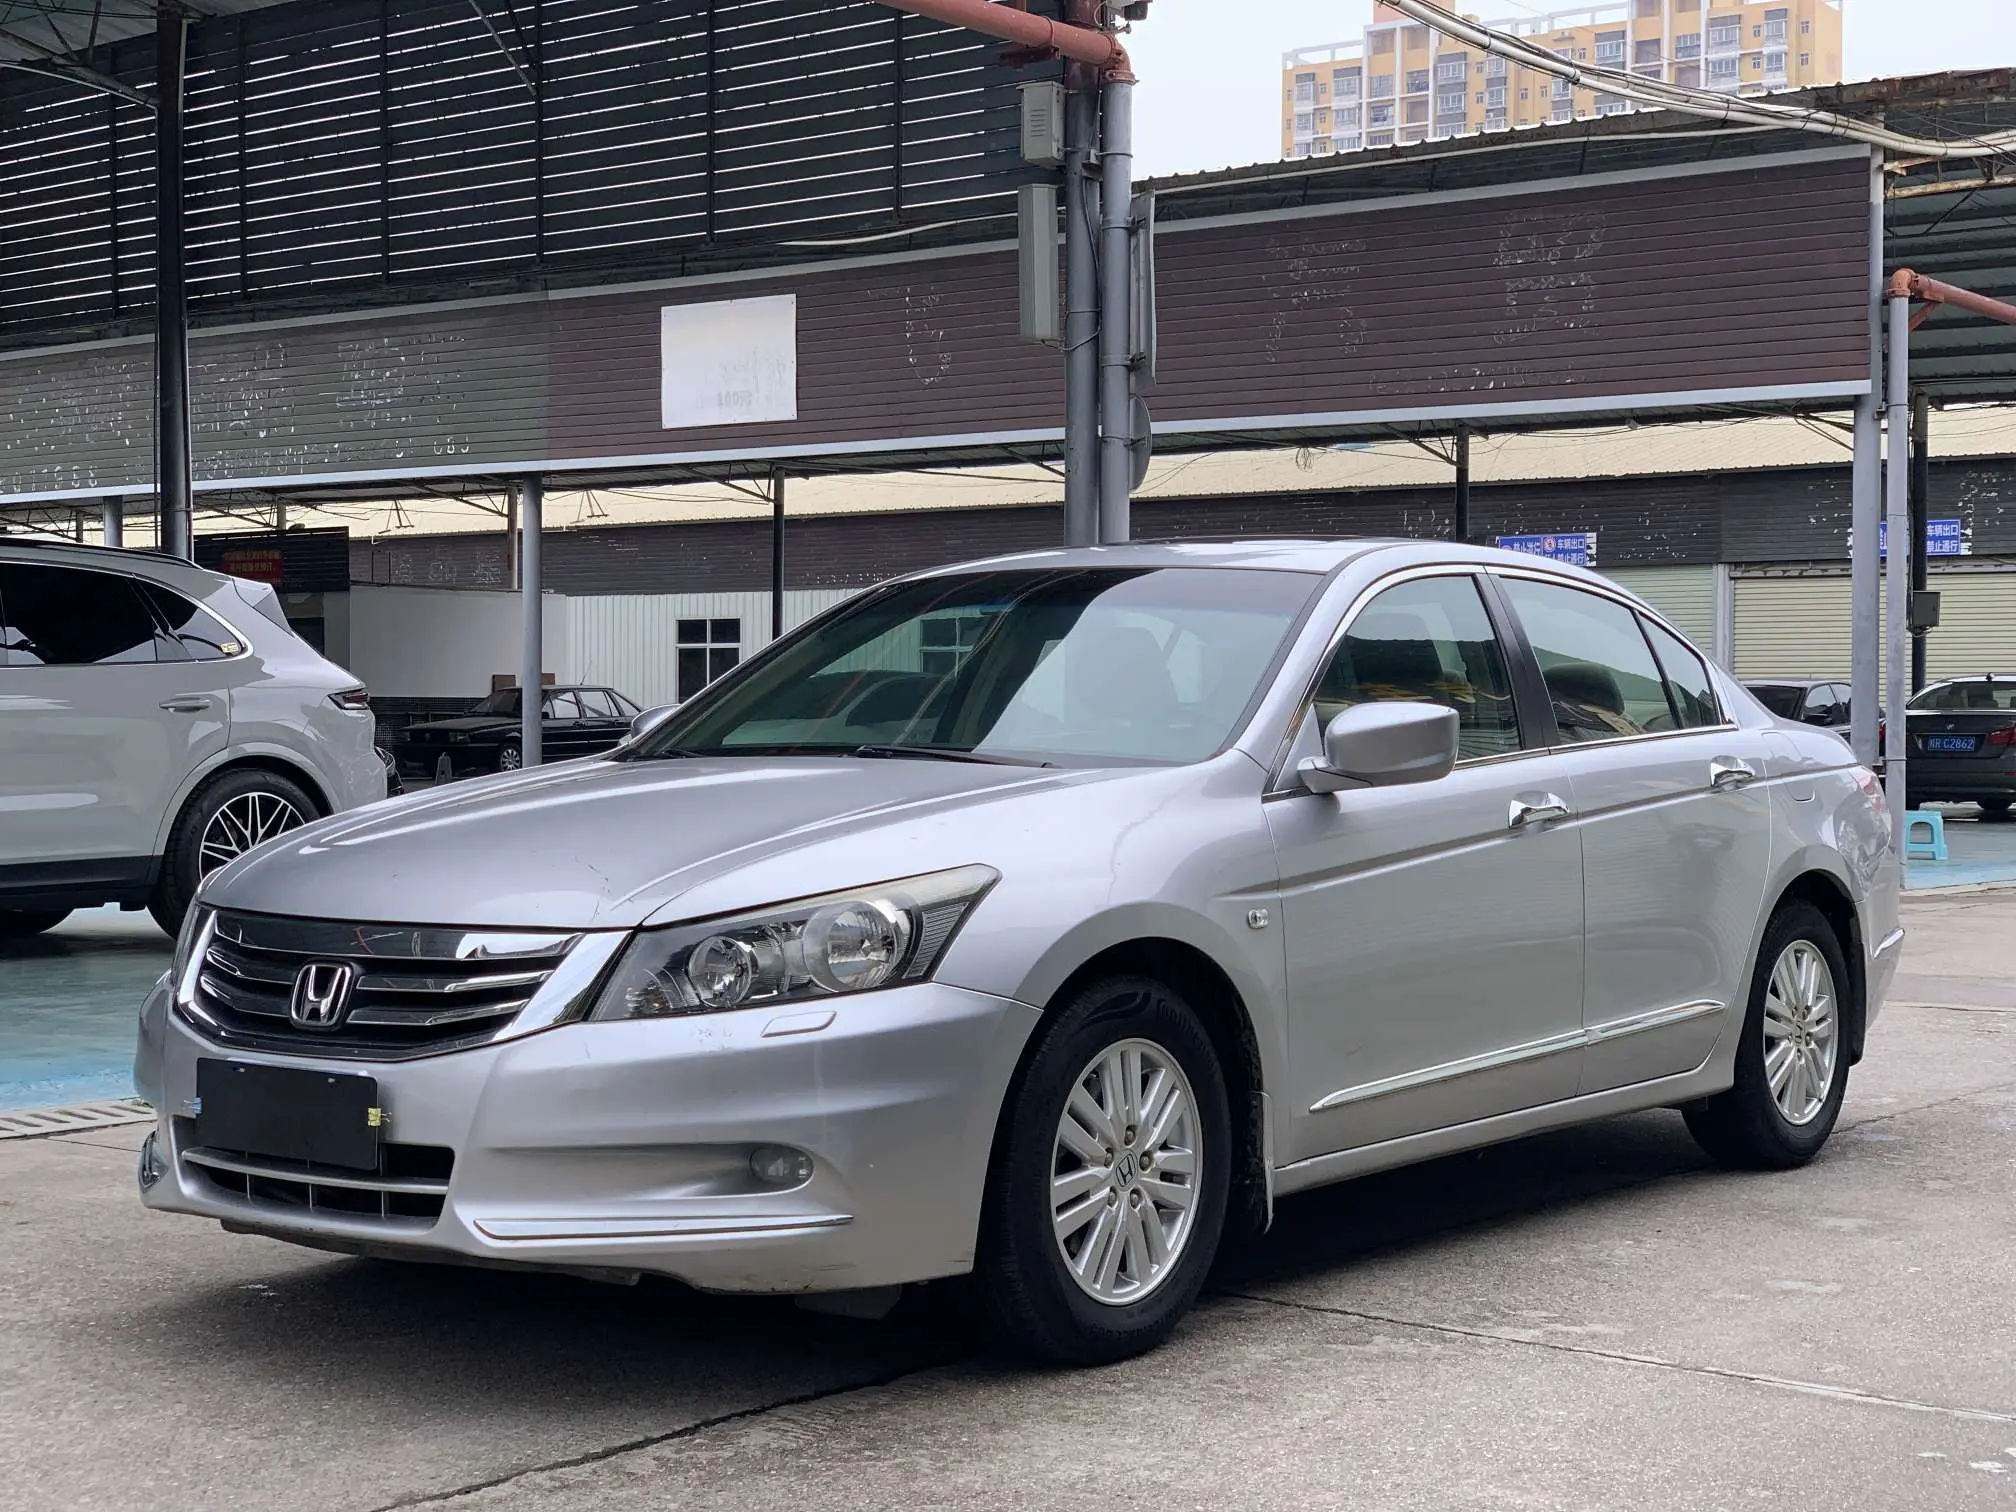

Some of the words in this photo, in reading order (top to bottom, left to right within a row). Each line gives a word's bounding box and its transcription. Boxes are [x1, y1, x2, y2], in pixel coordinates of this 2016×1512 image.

[1927, 524, 1959, 537] 车辆出口
[1926, 540, 1959, 553] 禁止通行
